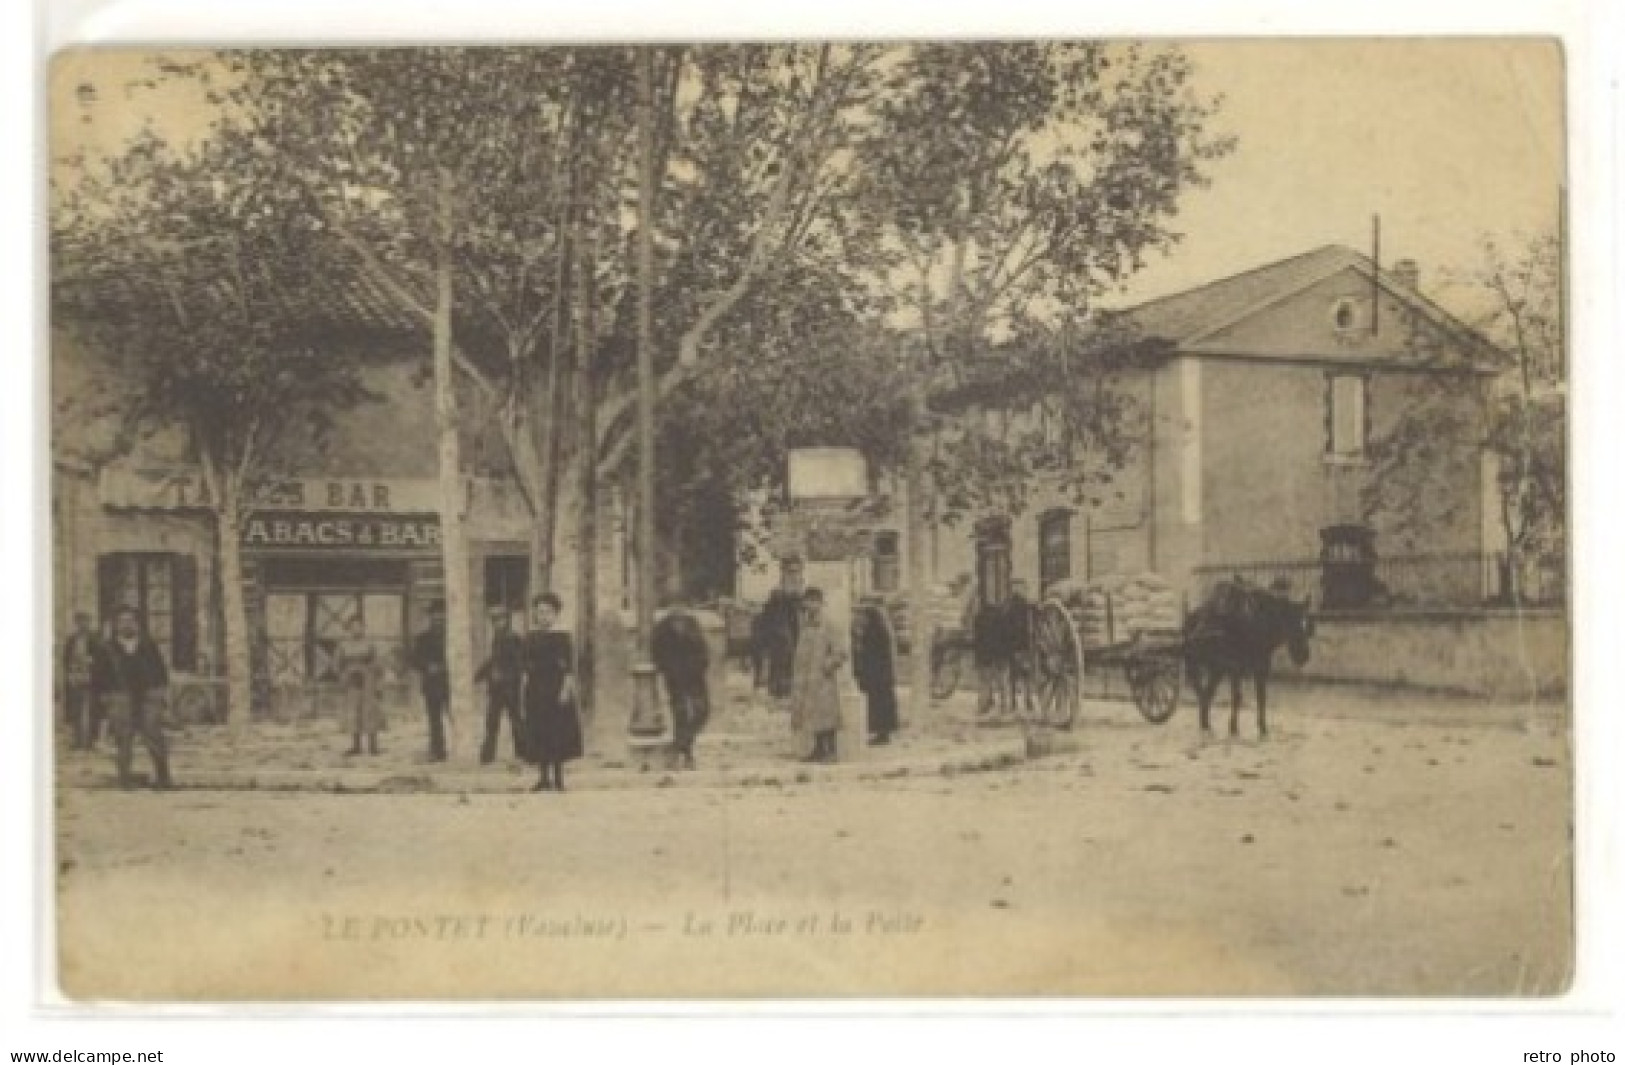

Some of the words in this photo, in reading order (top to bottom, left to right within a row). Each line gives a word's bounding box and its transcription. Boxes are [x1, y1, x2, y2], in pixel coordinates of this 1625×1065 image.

[327, 482, 391, 508] BAR
[244, 520, 352, 545] ABACS
[380, 522, 442, 545] BAR
